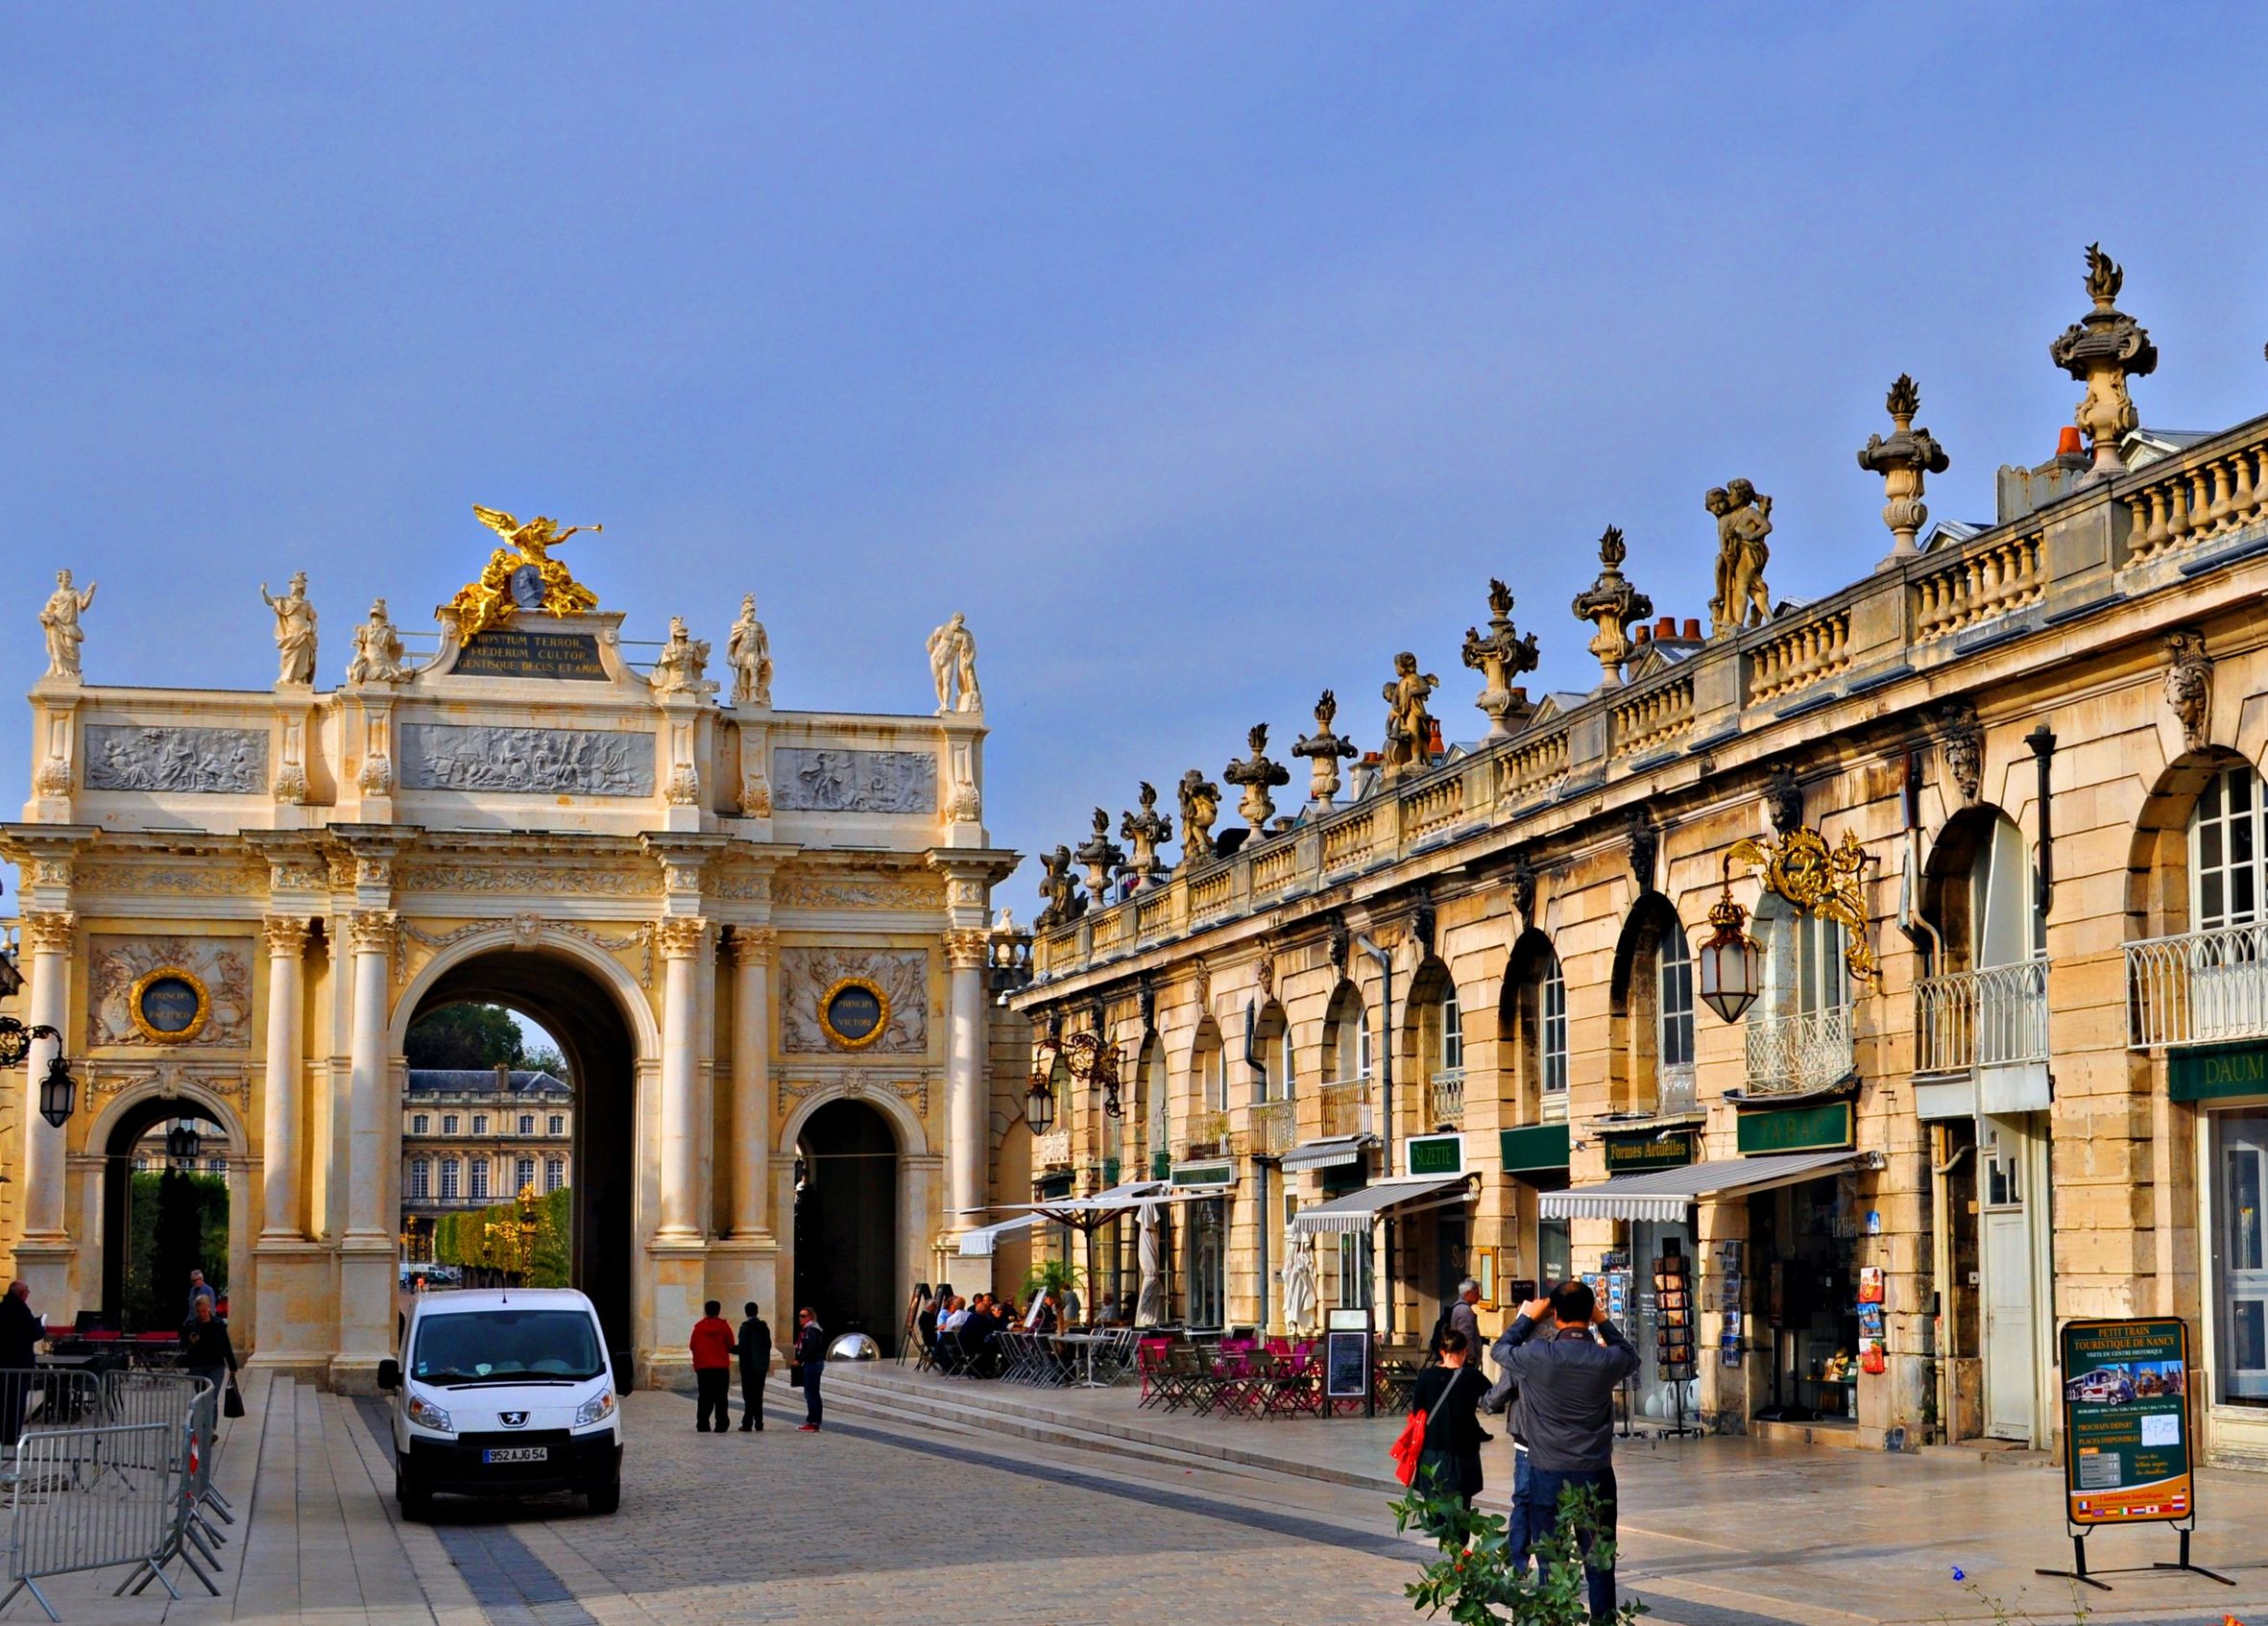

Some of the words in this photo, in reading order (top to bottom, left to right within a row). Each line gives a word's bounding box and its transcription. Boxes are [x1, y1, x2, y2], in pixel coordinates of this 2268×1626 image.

[521, 663, 554, 671] DECUS
[558, 664, 571, 672] ET
[2205, 1054, 2265, 1084] DAUM
[1760, 1113, 1825, 1143] TABAC
[1416, 1146, 1452, 1166] SUZETTE
[1610, 1143, 1643, 1160] Formes
[1644, 1139, 1686, 1157] Actuelles
[2098, 1327, 2122, 1338] PETIT
[2125, 1326, 2150, 1336] TRAIN
[2075, 1340, 2131, 1350] TOURISTIQUE
[2133, 1339, 2144, 1347] DE
[2147, 1336, 2175, 1346] NANCY
[491, 1450, 510, 1461] 952
[512, 1449, 530, 1460] AJG
[532, 1448, 545, 1459] 54
